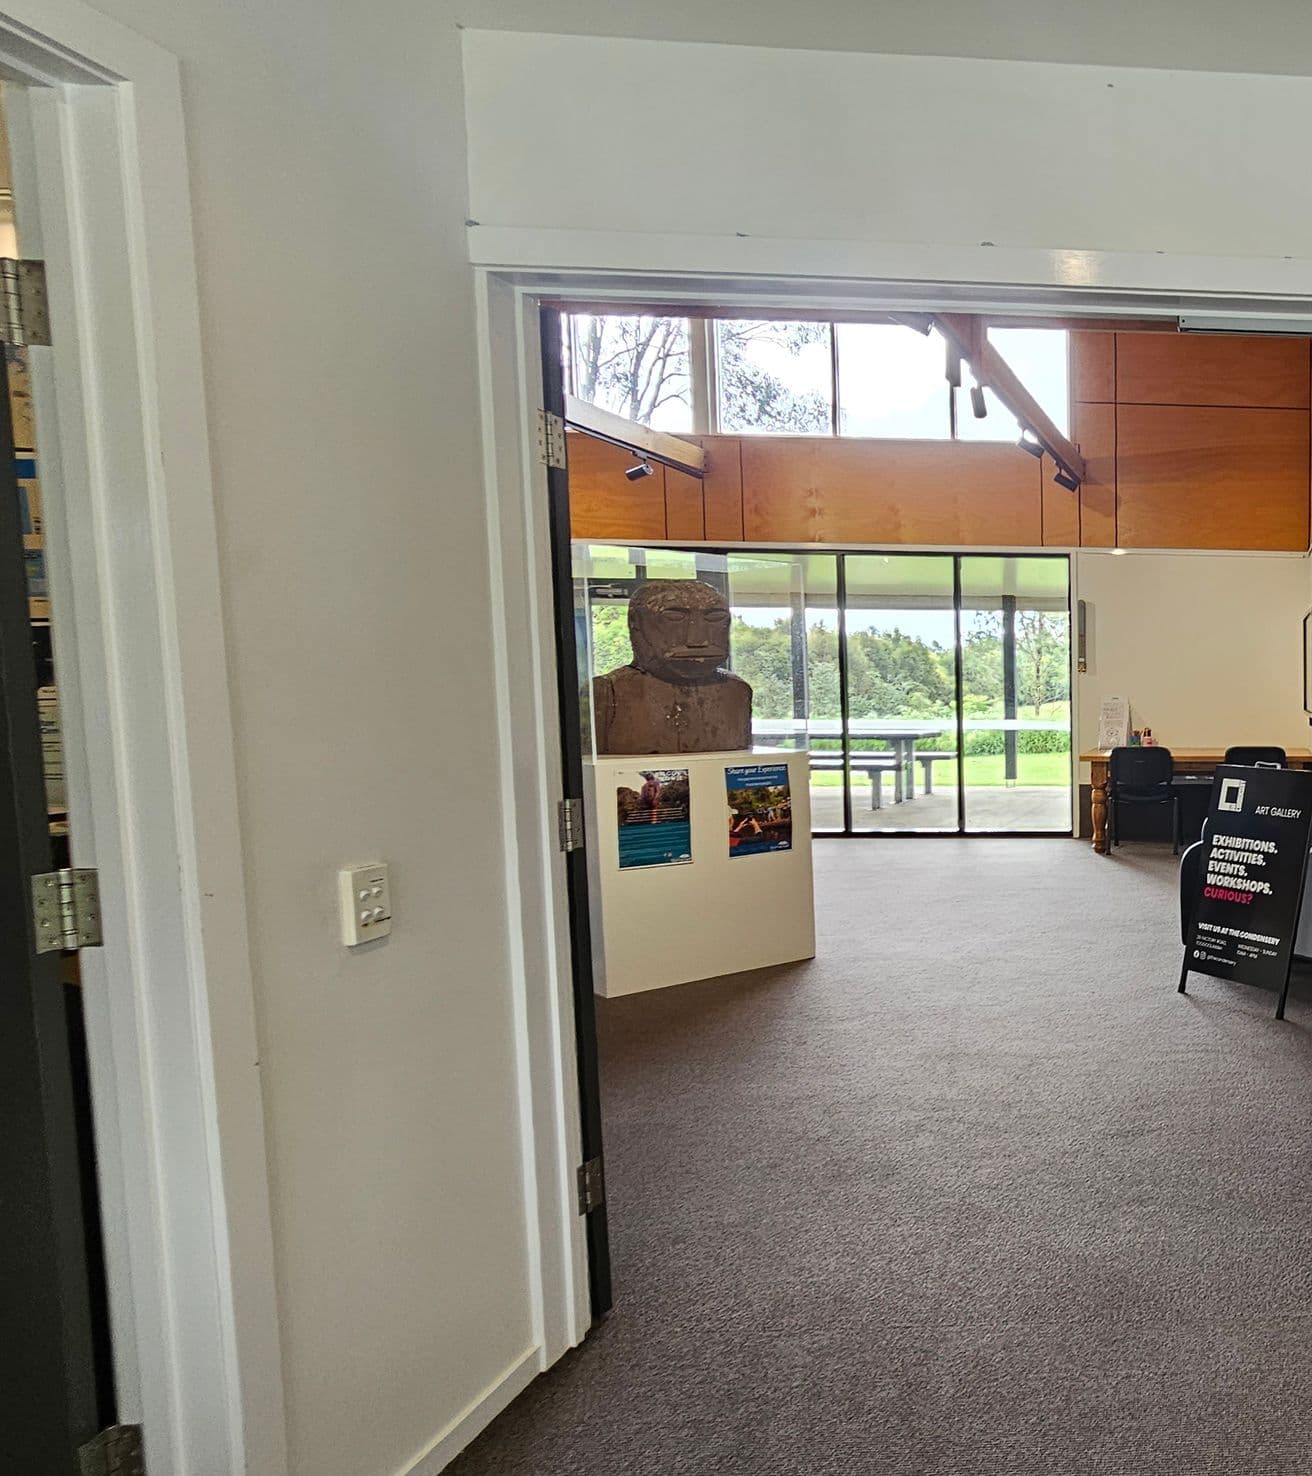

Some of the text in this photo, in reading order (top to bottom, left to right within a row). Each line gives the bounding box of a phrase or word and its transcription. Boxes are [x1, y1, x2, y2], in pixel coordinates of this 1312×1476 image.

[744, 767, 757, 776] your
[757, 766, 787, 774] Experience
[1254, 805, 1303, 819] ART GALLERY
[1212, 834, 1279, 854] EXHIBITIONS.
[1209, 847, 1267, 866] ACTIVITIES.
[1207, 860, 1248, 877] EVENTS.
[1206, 873, 1273, 895] WORKSHOPS.
[1203, 886, 1253, 905] CURIOUS?
[1198, 922, 1281, 946] VISIT US AT THE CONDENSERY
